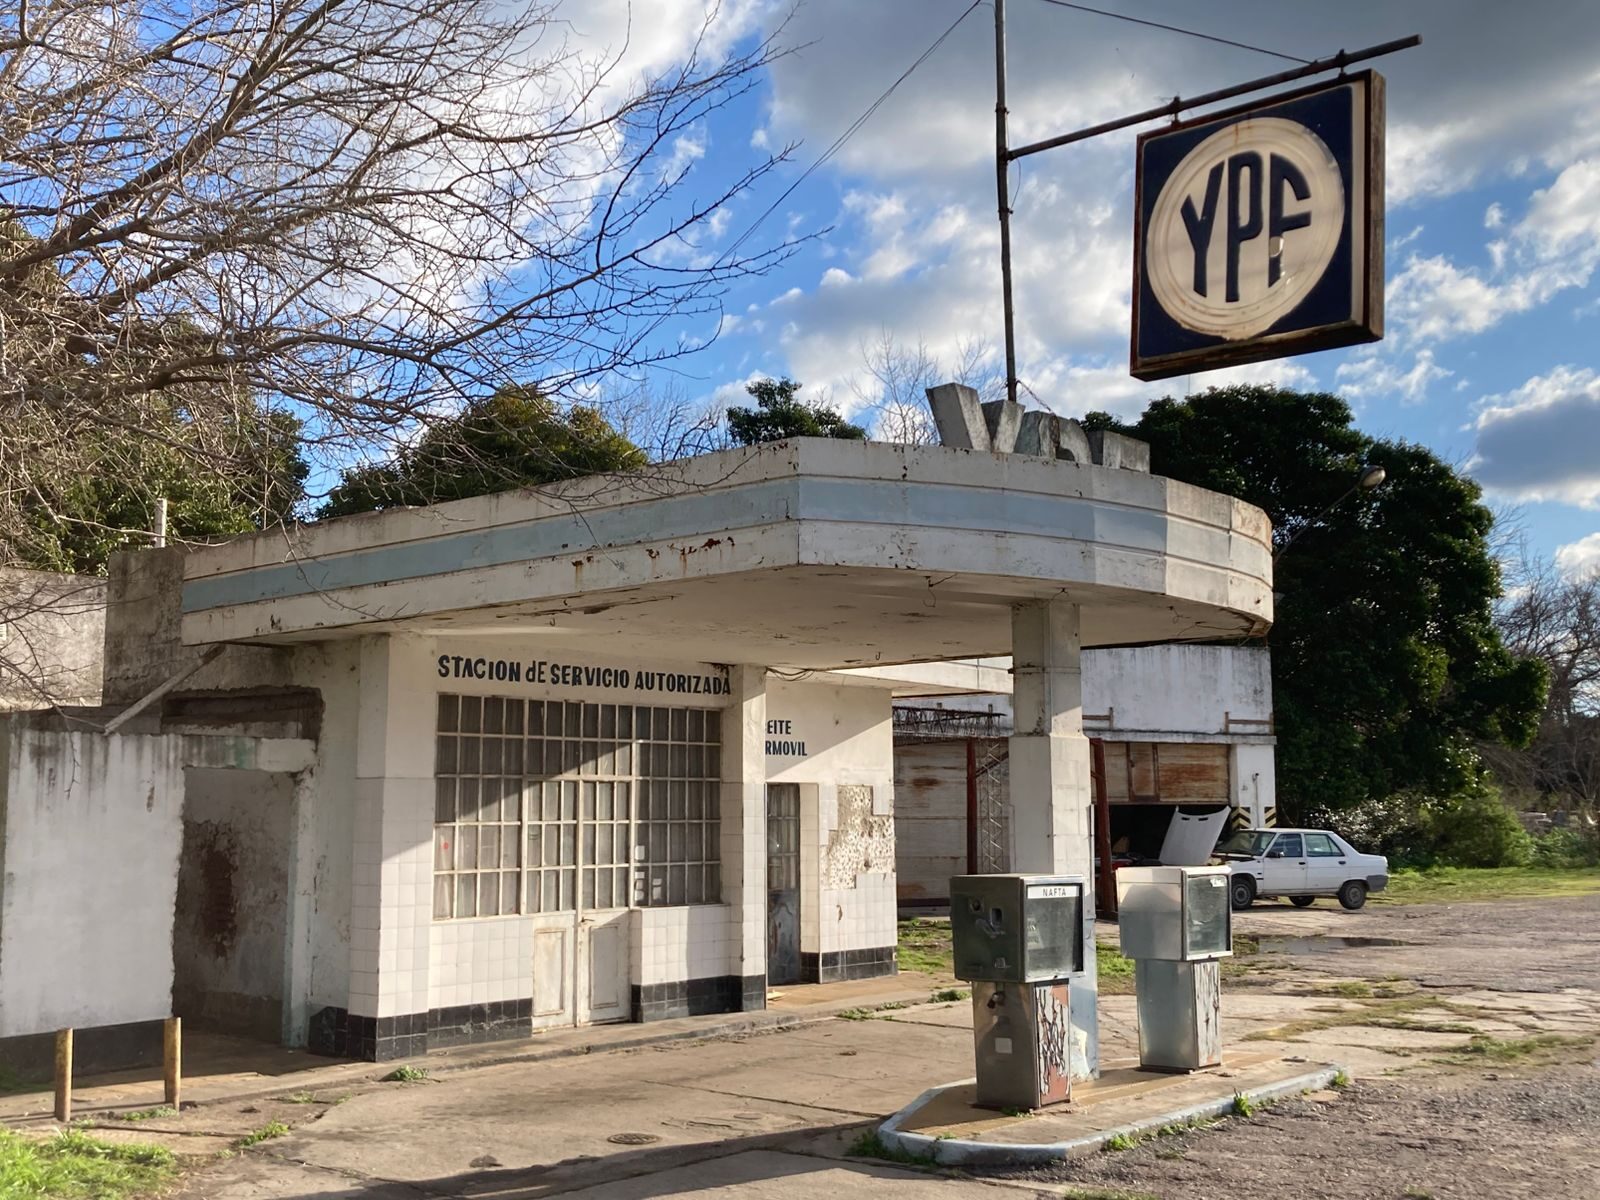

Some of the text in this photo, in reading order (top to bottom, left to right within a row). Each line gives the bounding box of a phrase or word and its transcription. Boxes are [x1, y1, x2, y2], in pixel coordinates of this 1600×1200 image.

[1180, 150, 1312, 303] YPF
[550, 664, 630, 690] SERVICIO
[634, 671, 731, 695] AUTORIZADA
[765, 719, 792, 735] EITE
[1042, 887, 1067, 897] NAFTA
